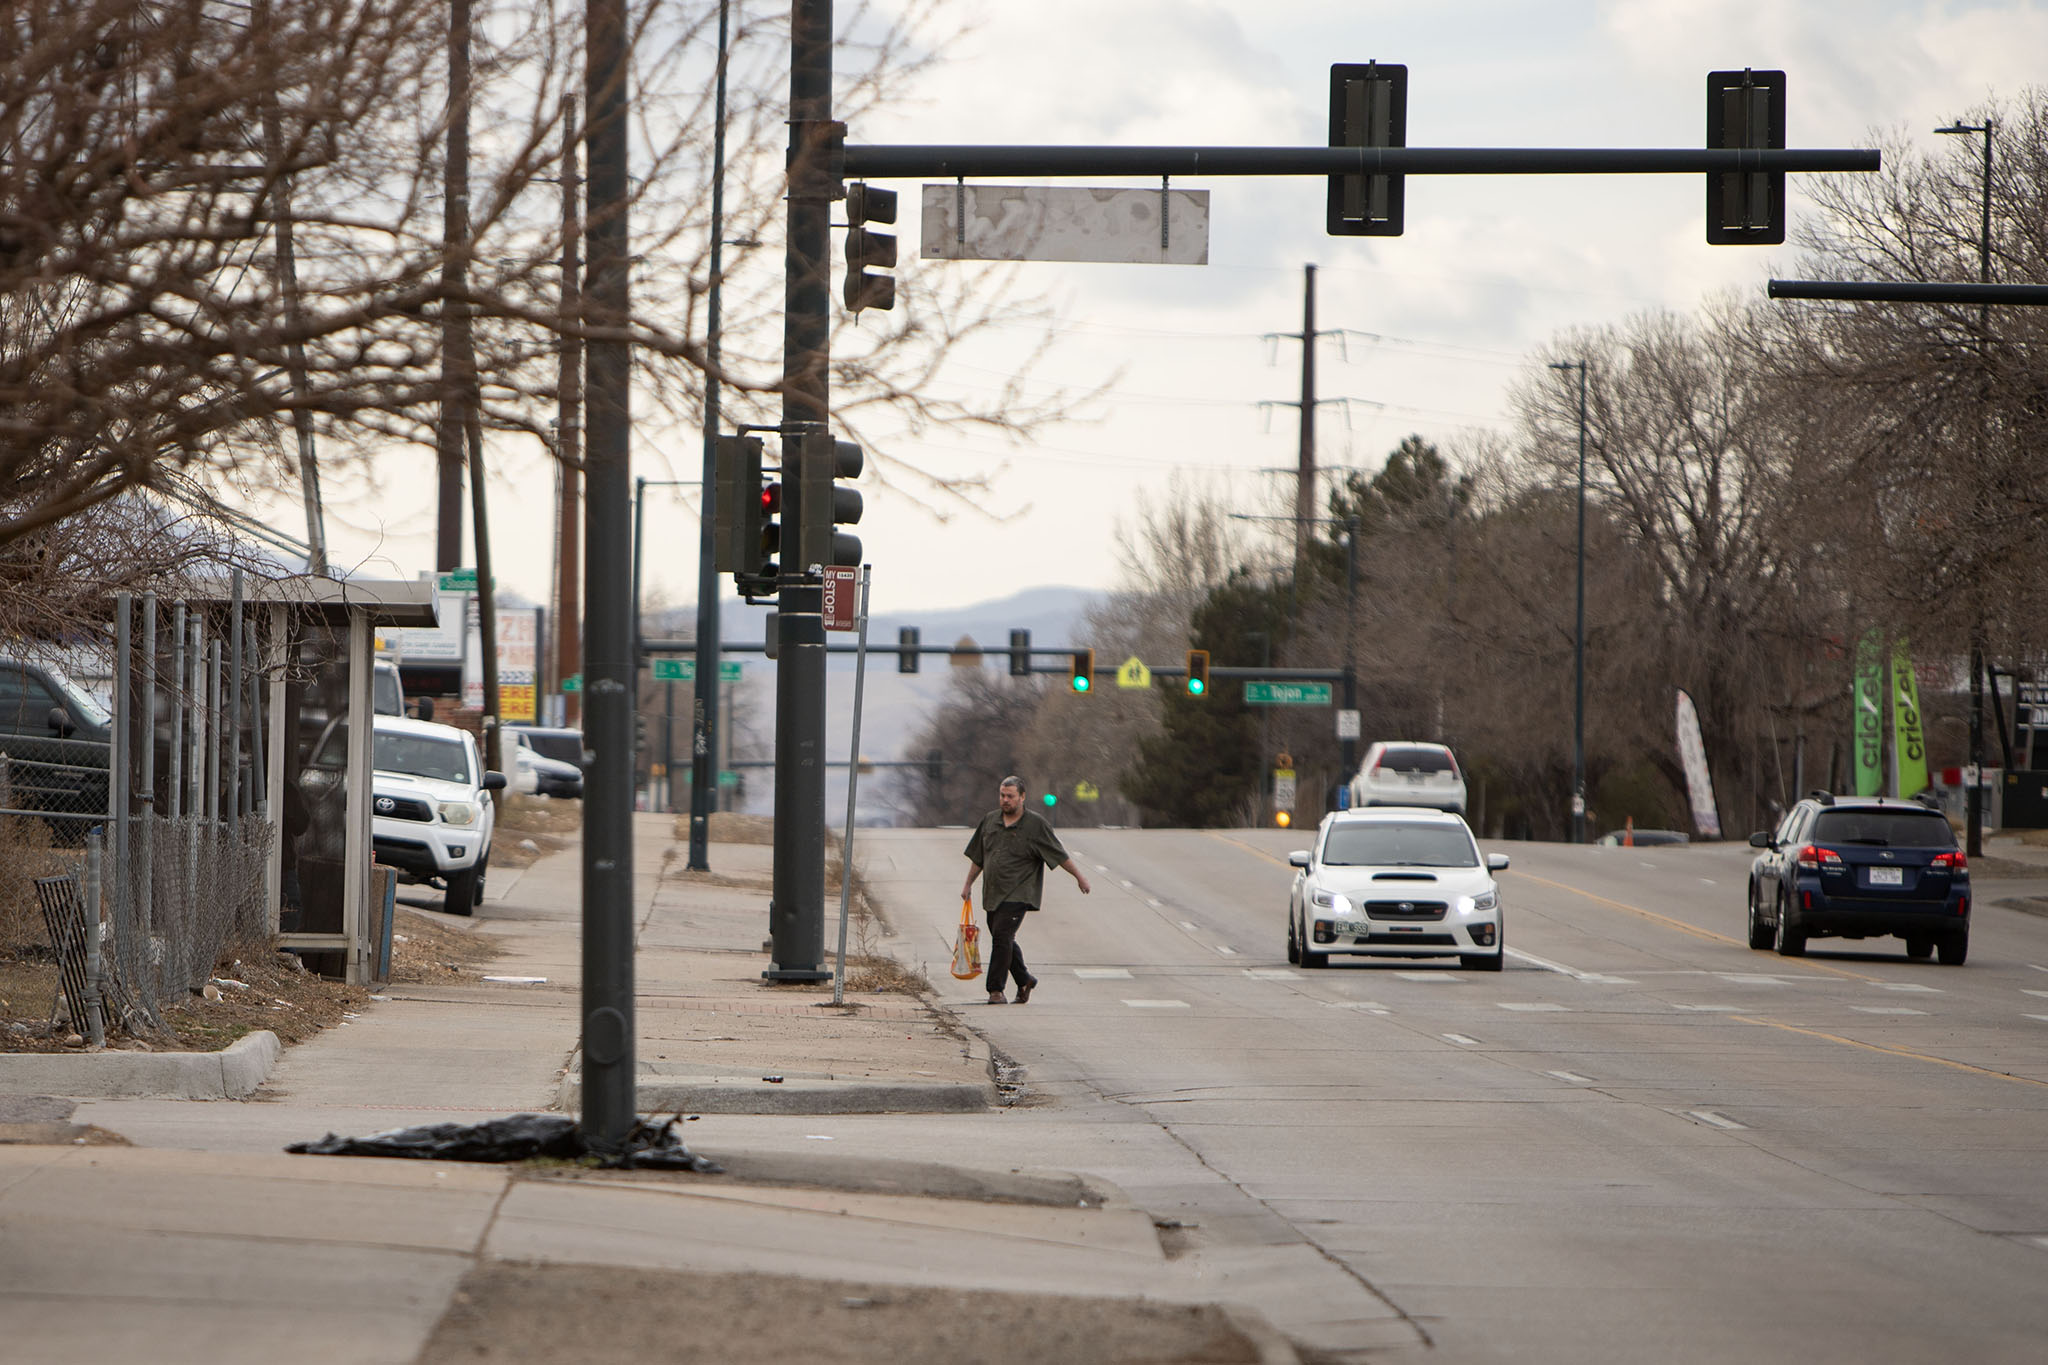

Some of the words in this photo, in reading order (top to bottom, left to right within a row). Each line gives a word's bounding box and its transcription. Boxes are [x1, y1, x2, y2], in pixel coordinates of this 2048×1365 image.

[825, 570, 836, 579] MY
[825, 580, 836, 613] STOP
[1271, 684, 1302, 703] Tejon
